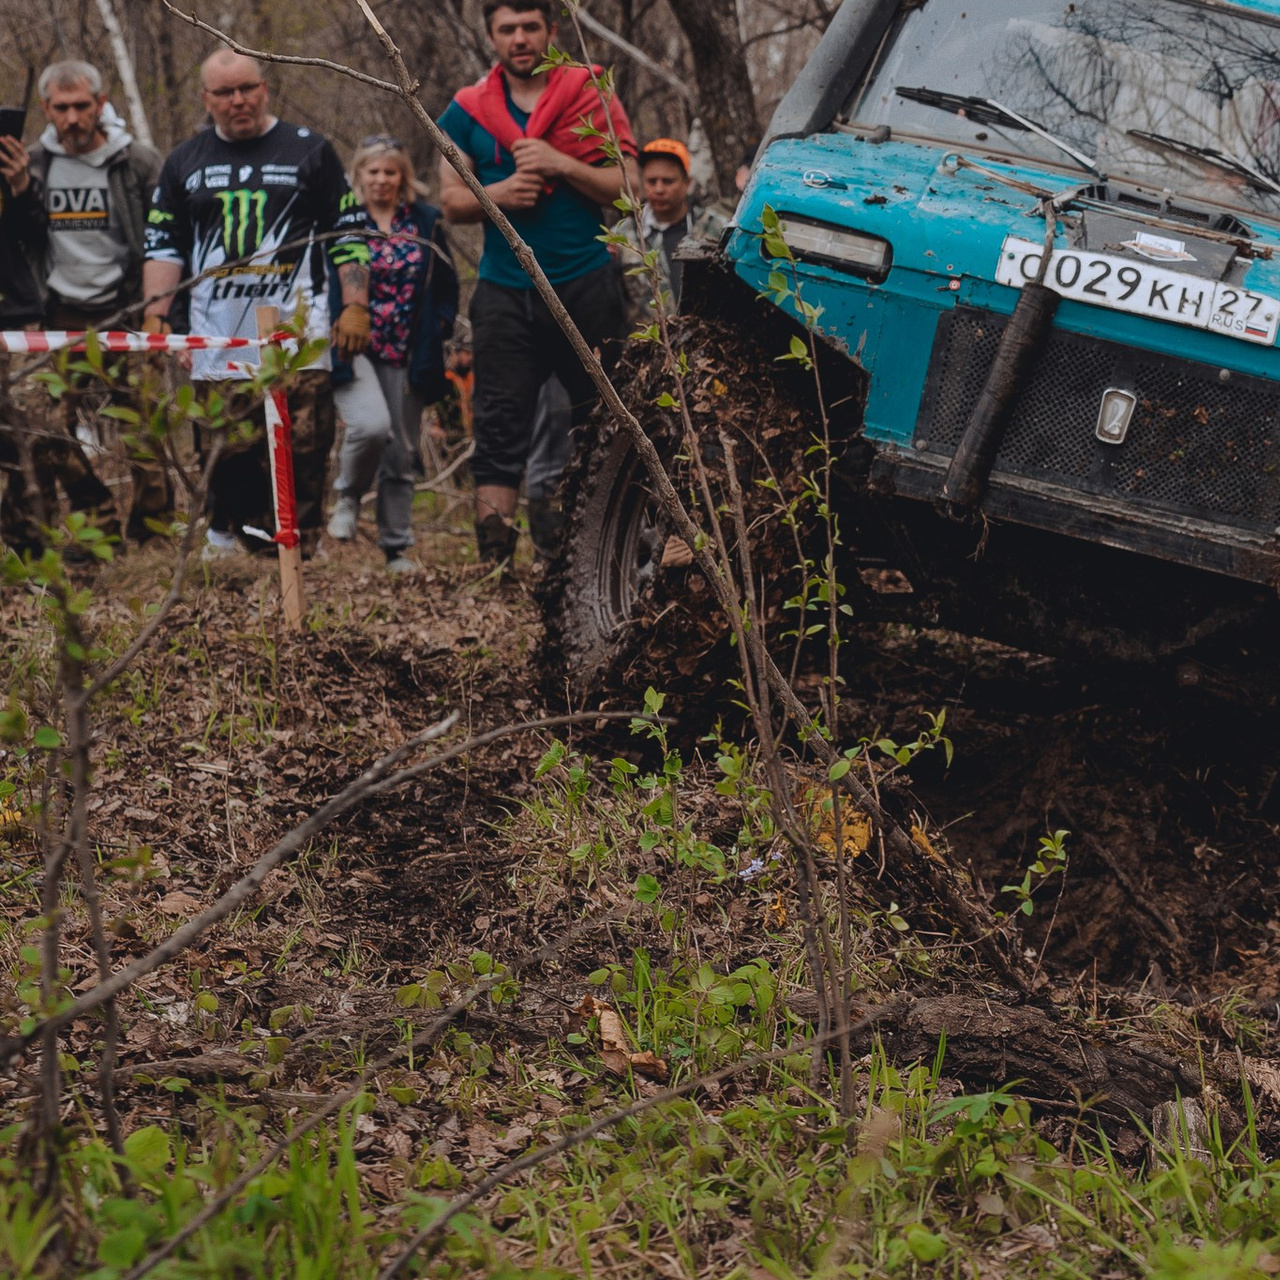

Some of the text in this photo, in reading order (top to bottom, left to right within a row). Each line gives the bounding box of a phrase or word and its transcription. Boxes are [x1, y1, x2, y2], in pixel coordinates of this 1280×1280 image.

[49, 188, 105, 212] DVA
[1218, 290, 1263, 320] 27
[1211, 313, 1244, 331] RUS
